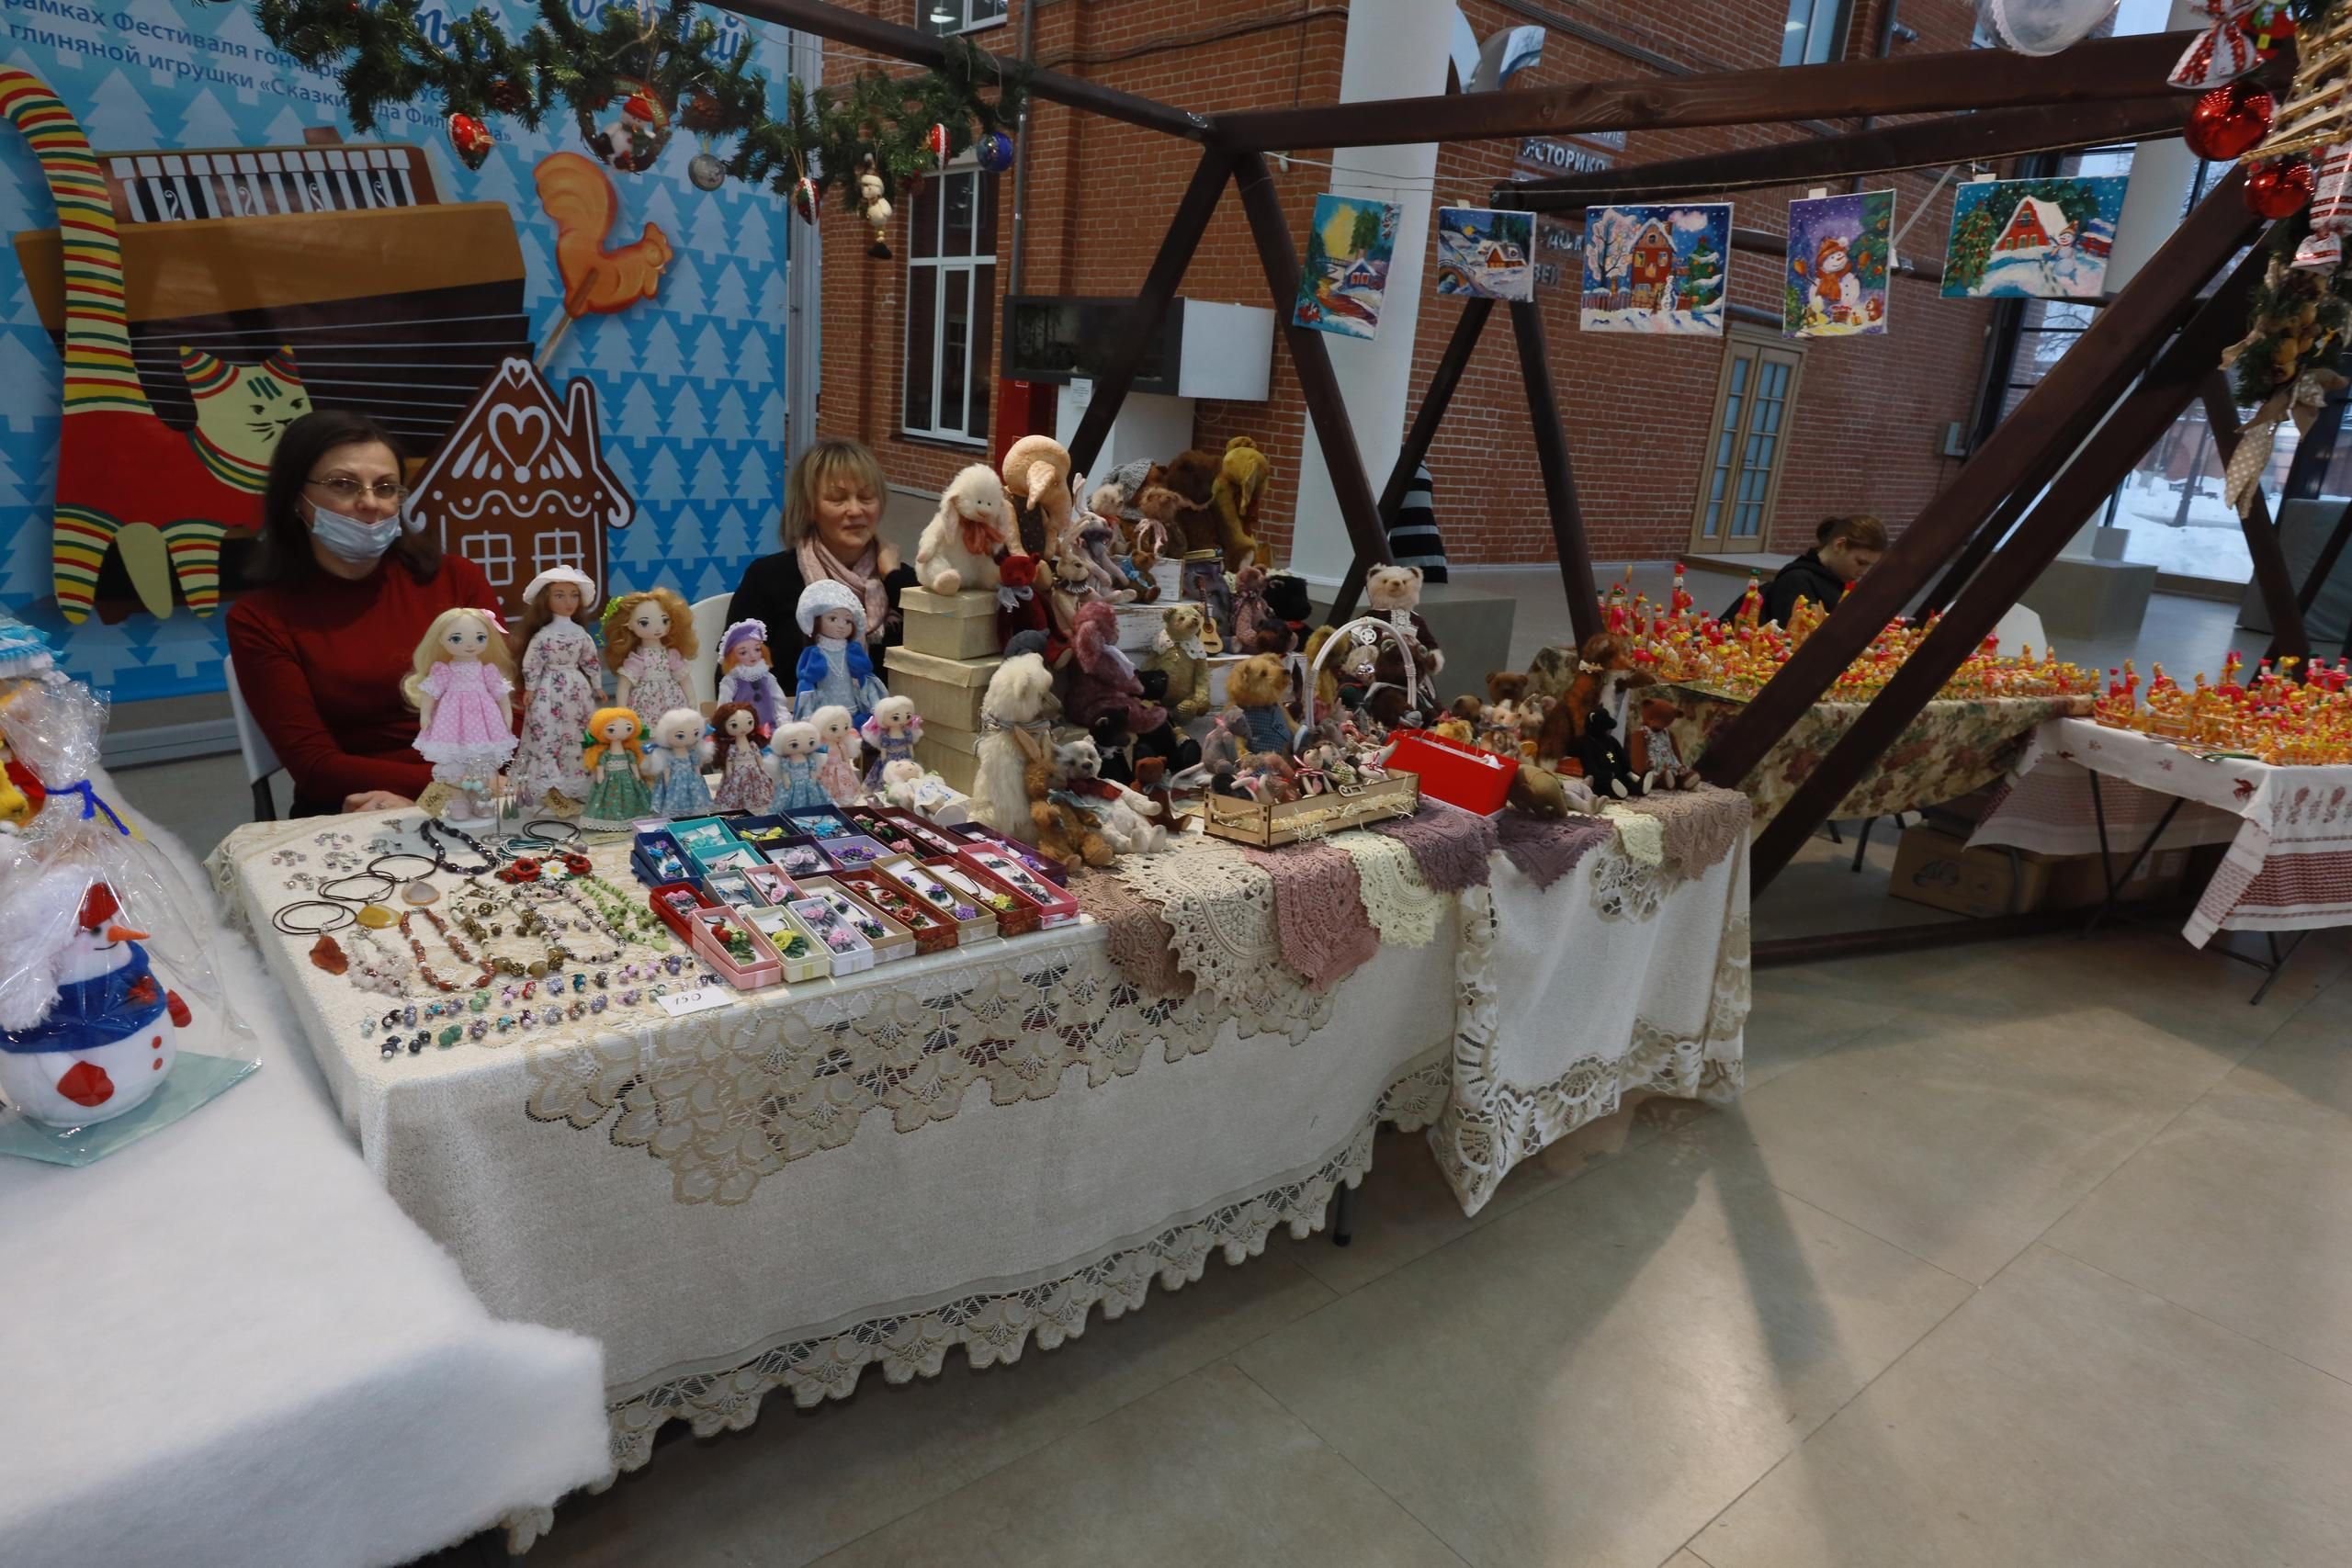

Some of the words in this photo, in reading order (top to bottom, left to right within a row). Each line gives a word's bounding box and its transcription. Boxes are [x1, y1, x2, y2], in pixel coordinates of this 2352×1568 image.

[9, 24, 141, 65] глиняной
[149, 53, 254, 90] игрушки
[112, 10, 248, 60] Фестиваля
